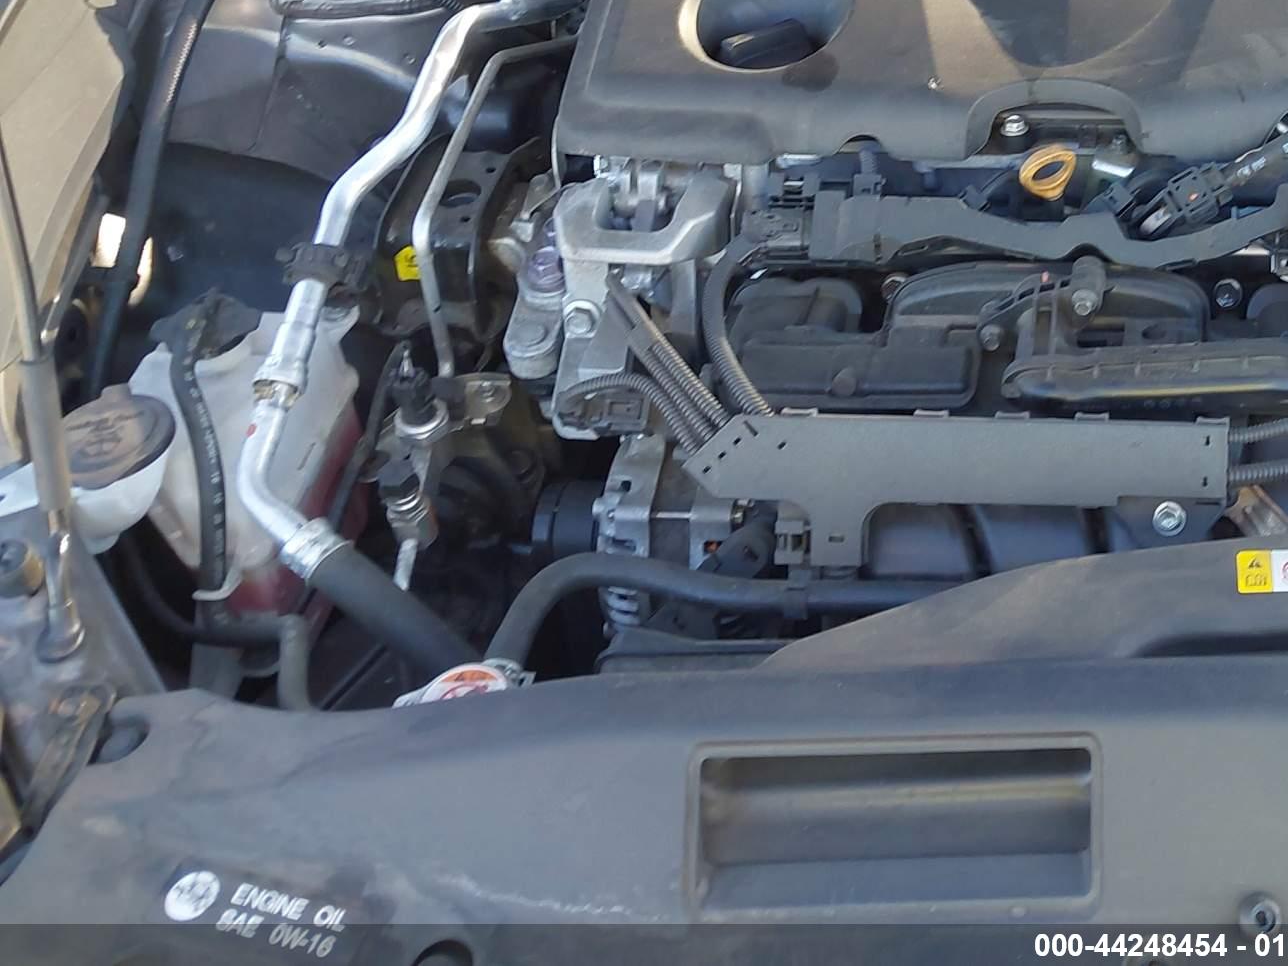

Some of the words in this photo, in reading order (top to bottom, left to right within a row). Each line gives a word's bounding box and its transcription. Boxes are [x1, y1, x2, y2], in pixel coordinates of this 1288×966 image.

[230, 882, 309, 920] ENGINE
[313, 904, 347, 932] OIL
[215, 908, 265, 938] SAE
[268, 922, 337, 958] 0W-16
